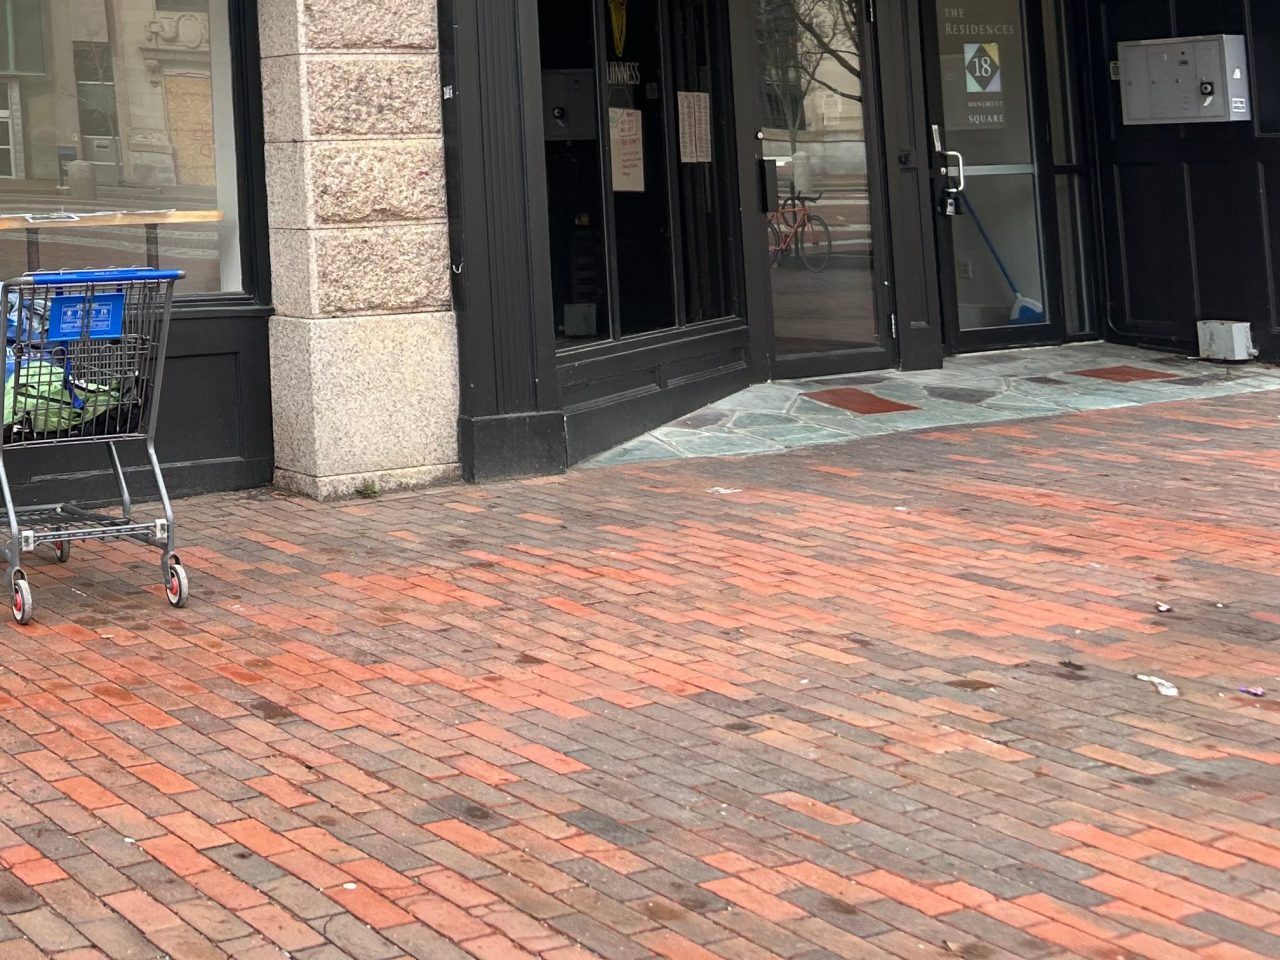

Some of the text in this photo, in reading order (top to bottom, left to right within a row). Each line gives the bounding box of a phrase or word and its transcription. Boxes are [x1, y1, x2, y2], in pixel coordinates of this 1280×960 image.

[944, 8, 965, 18] THE
[945, 23, 1015, 35] RESIDENCES
[973, 56, 992, 77] 18
[606, 61, 640, 85] UINNESS
[968, 114, 1005, 125] SQUARE
